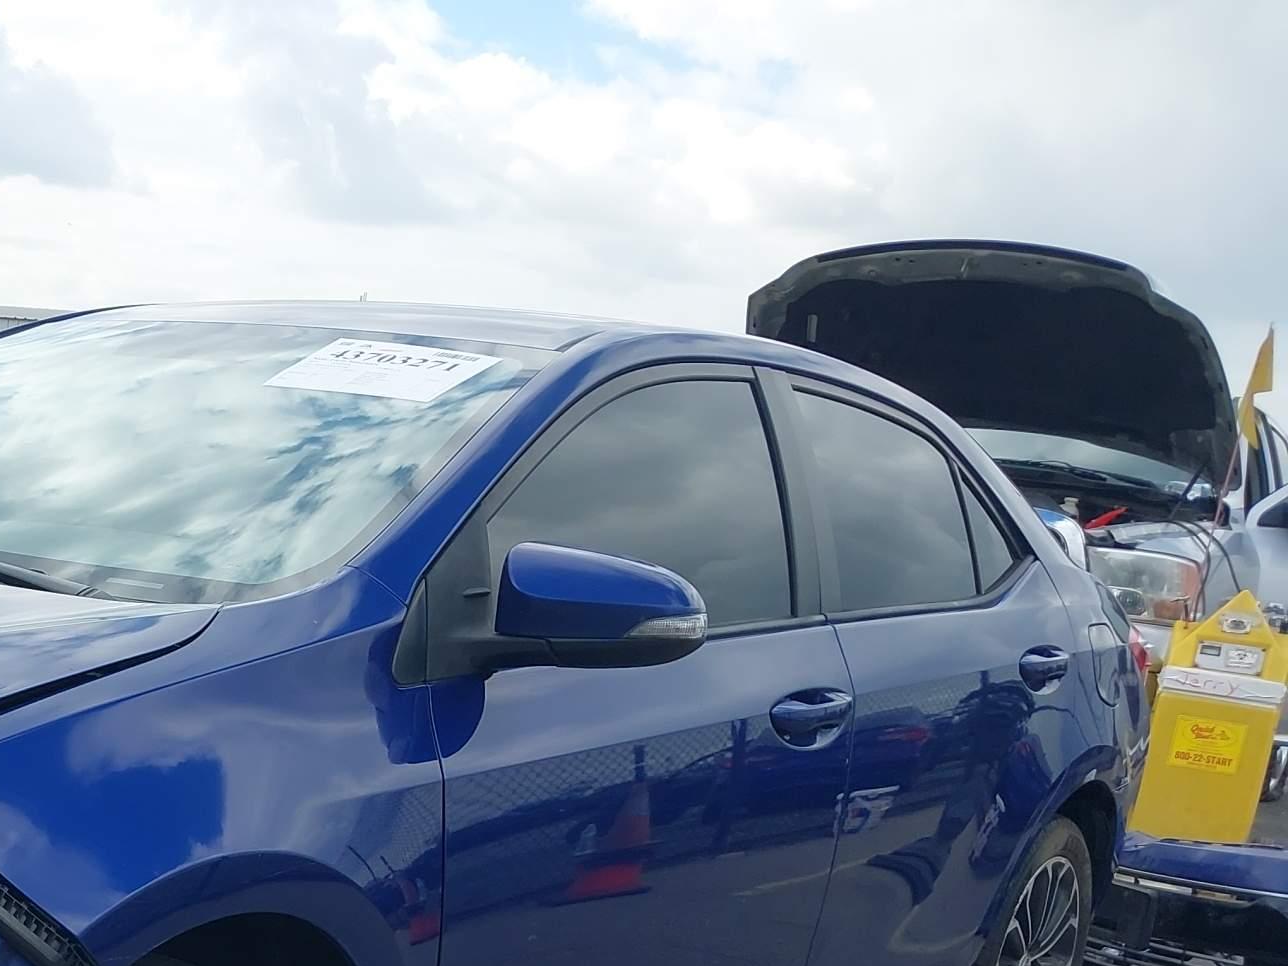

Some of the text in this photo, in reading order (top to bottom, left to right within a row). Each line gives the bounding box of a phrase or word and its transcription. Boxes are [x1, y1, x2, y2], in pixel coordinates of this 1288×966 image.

[330, 349, 461, 372] 43703271
[1178, 671, 1239, 695] Jerry
[1174, 750, 1233, 767] 800-22-START
